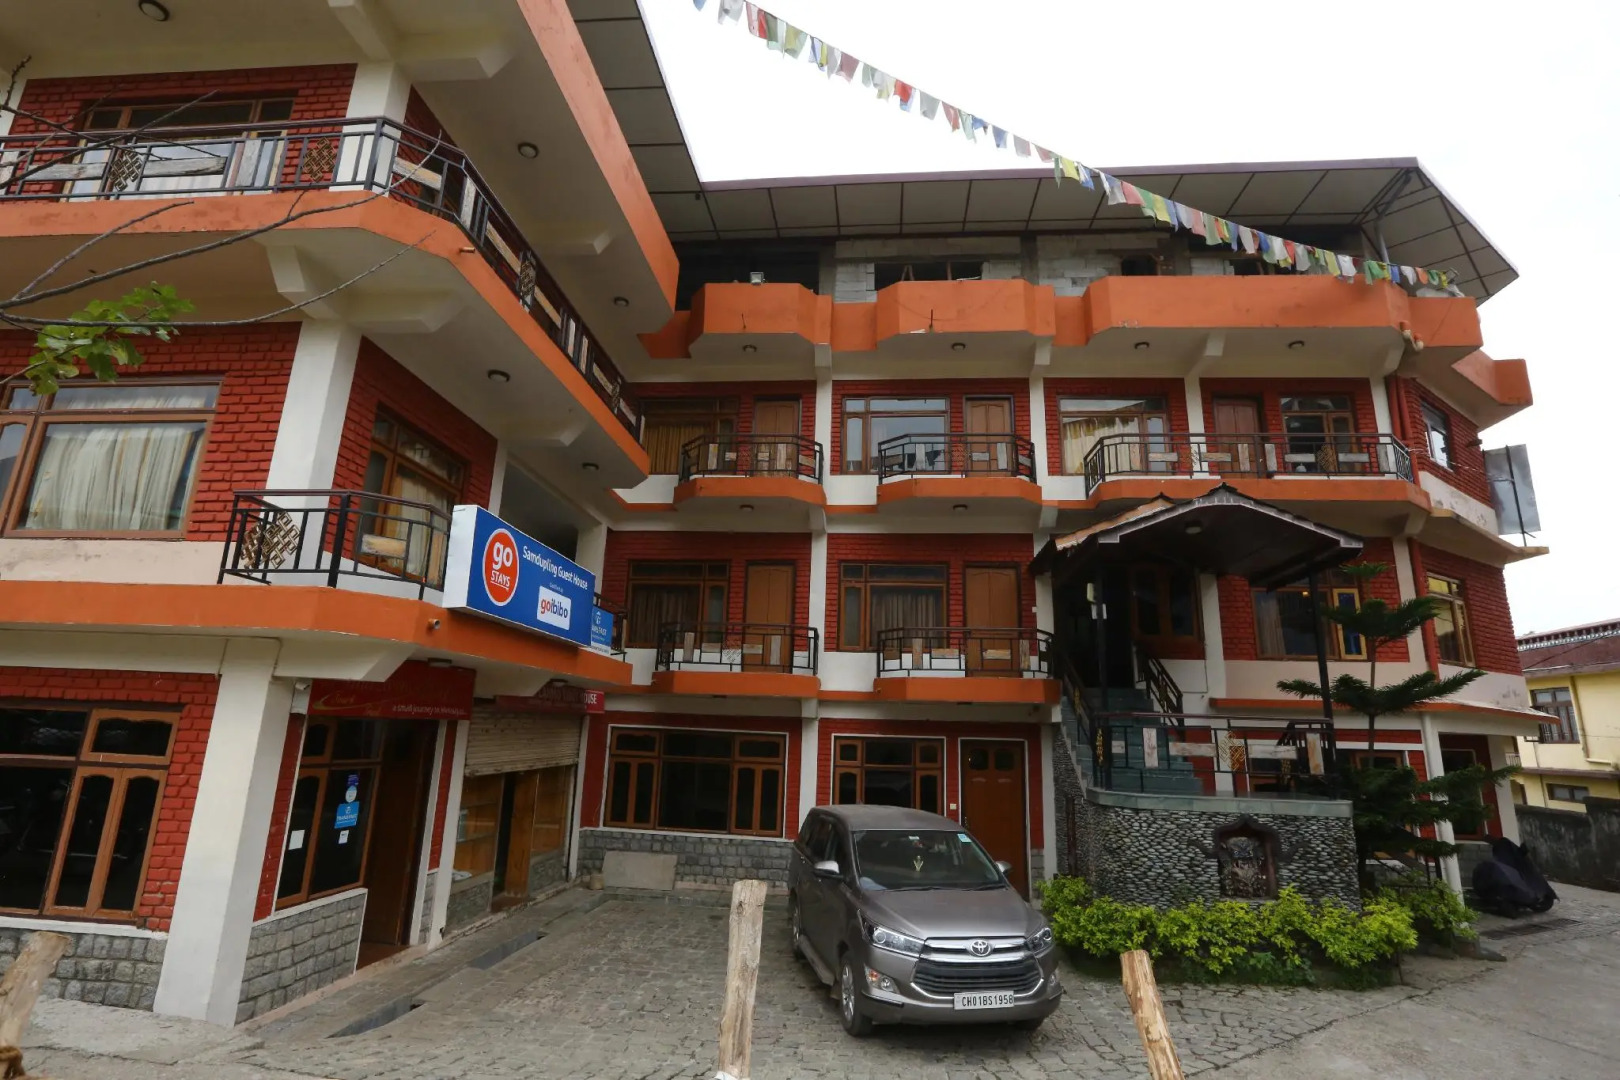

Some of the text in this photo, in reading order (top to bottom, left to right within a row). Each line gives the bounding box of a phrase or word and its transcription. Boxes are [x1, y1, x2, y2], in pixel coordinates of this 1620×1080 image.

[494, 542, 513, 570] go
[523, 546, 557, 577] Samdupling
[558, 567, 573, 583] Guest
[573, 574, 587, 590] House
[491, 571, 510, 587] STAYS
[541, 598, 568, 618] goibibo
[962, 994, 1014, 1007] CH01BS1958
